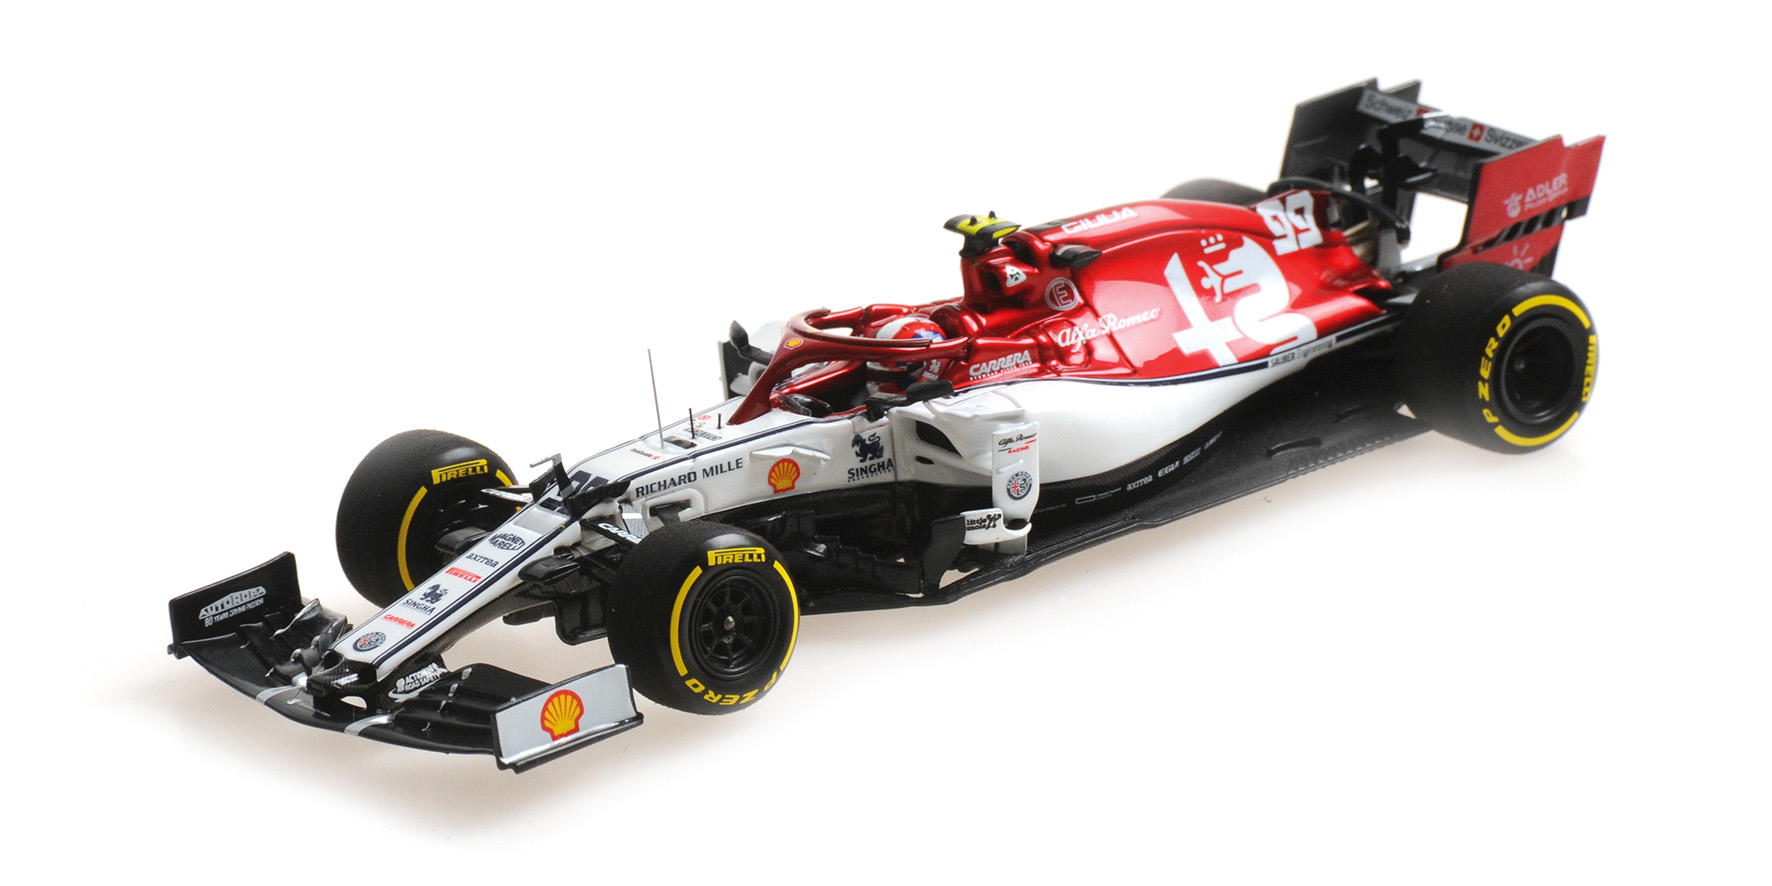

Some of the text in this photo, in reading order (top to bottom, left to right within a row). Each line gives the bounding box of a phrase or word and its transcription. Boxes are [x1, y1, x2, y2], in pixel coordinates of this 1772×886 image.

[1524, 172, 1568, 203] ADLER
[1061, 206, 1138, 234] GIULIA
[1256, 189, 1323, 255] 99
[1057, 307, 1161, 353] Alfa Romeo
[969, 349, 1032, 376] CARRERA
[1478, 314, 1511, 423] P ZERO
[1582, 335, 1597, 403] PIRELLI
[431, 459, 488, 485] PIRELLI
[635, 457, 744, 498] RICHARD MILLE
[847, 457, 894, 480] SINGHA
[707, 547, 766, 566] PIRELLI
[445, 566, 482, 583] PIRELLI
[402, 598, 436, 616] SINGHA
[684, 671, 778, 706] P ZERO
